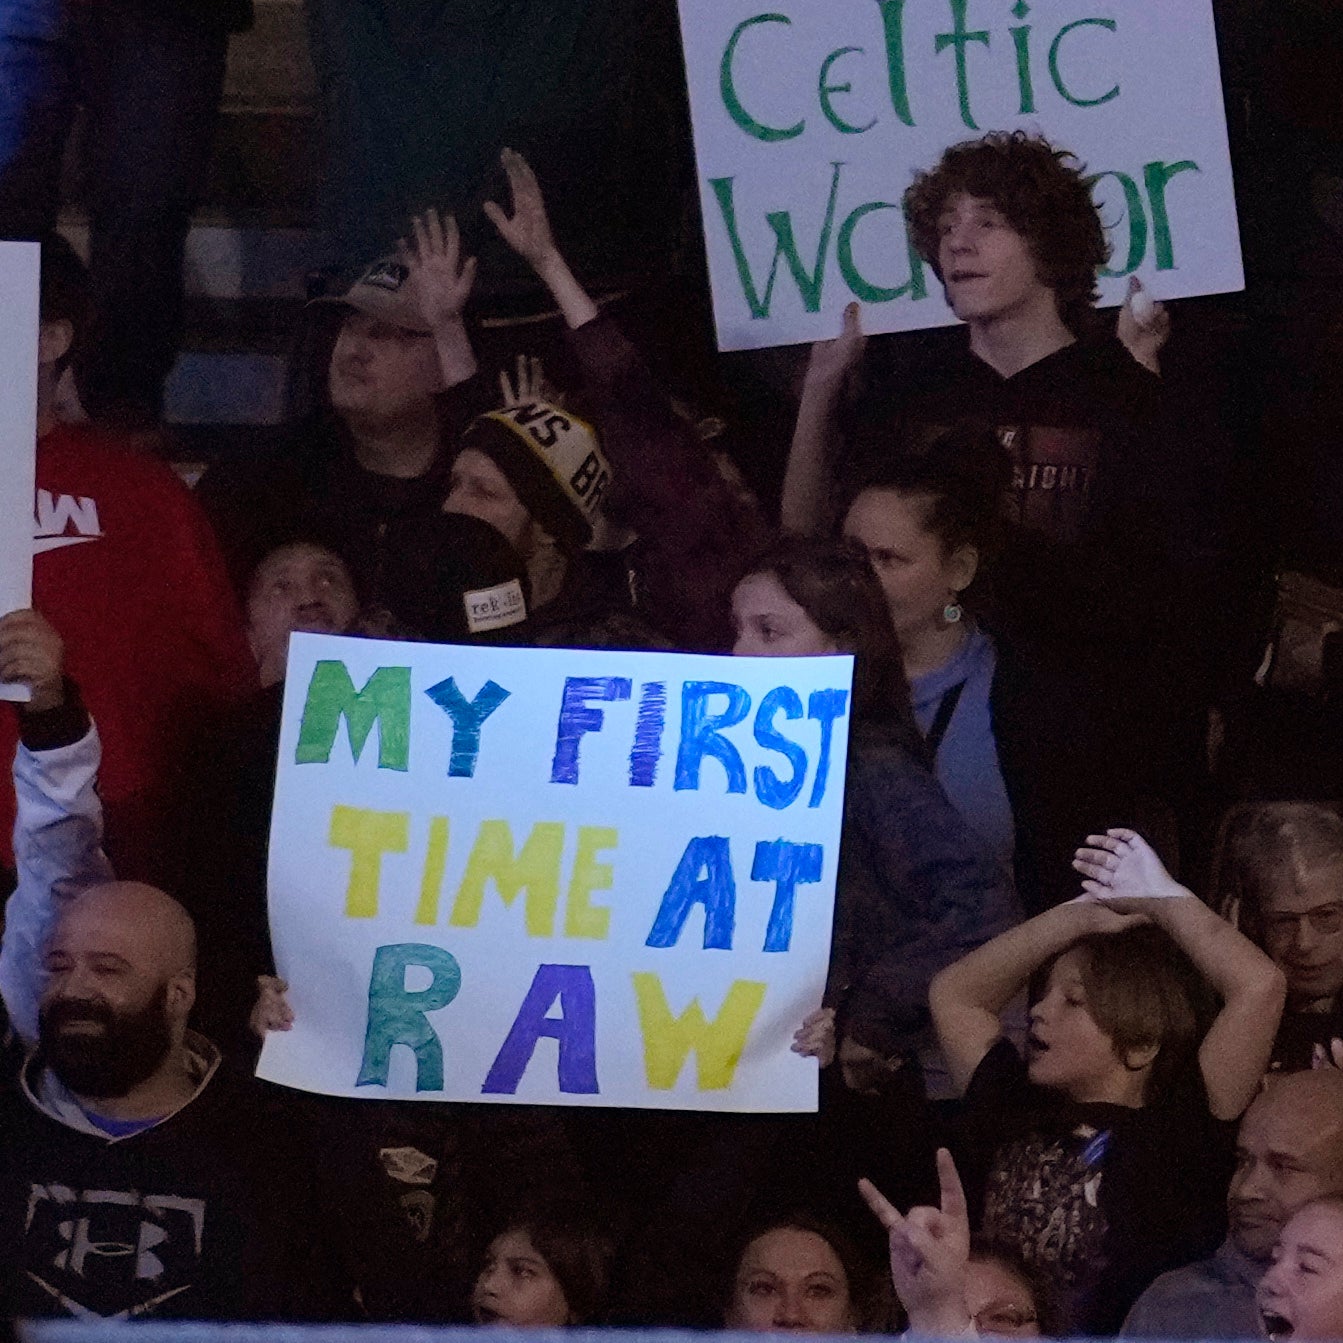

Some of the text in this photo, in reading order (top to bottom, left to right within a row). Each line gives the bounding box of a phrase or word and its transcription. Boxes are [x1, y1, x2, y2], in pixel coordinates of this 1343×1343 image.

[708, 159, 1201, 320] Waor
[294, 659, 849, 810] MY FIRST
[329, 802, 824, 953] TIME AT
[354, 941, 767, 1096] RAW
